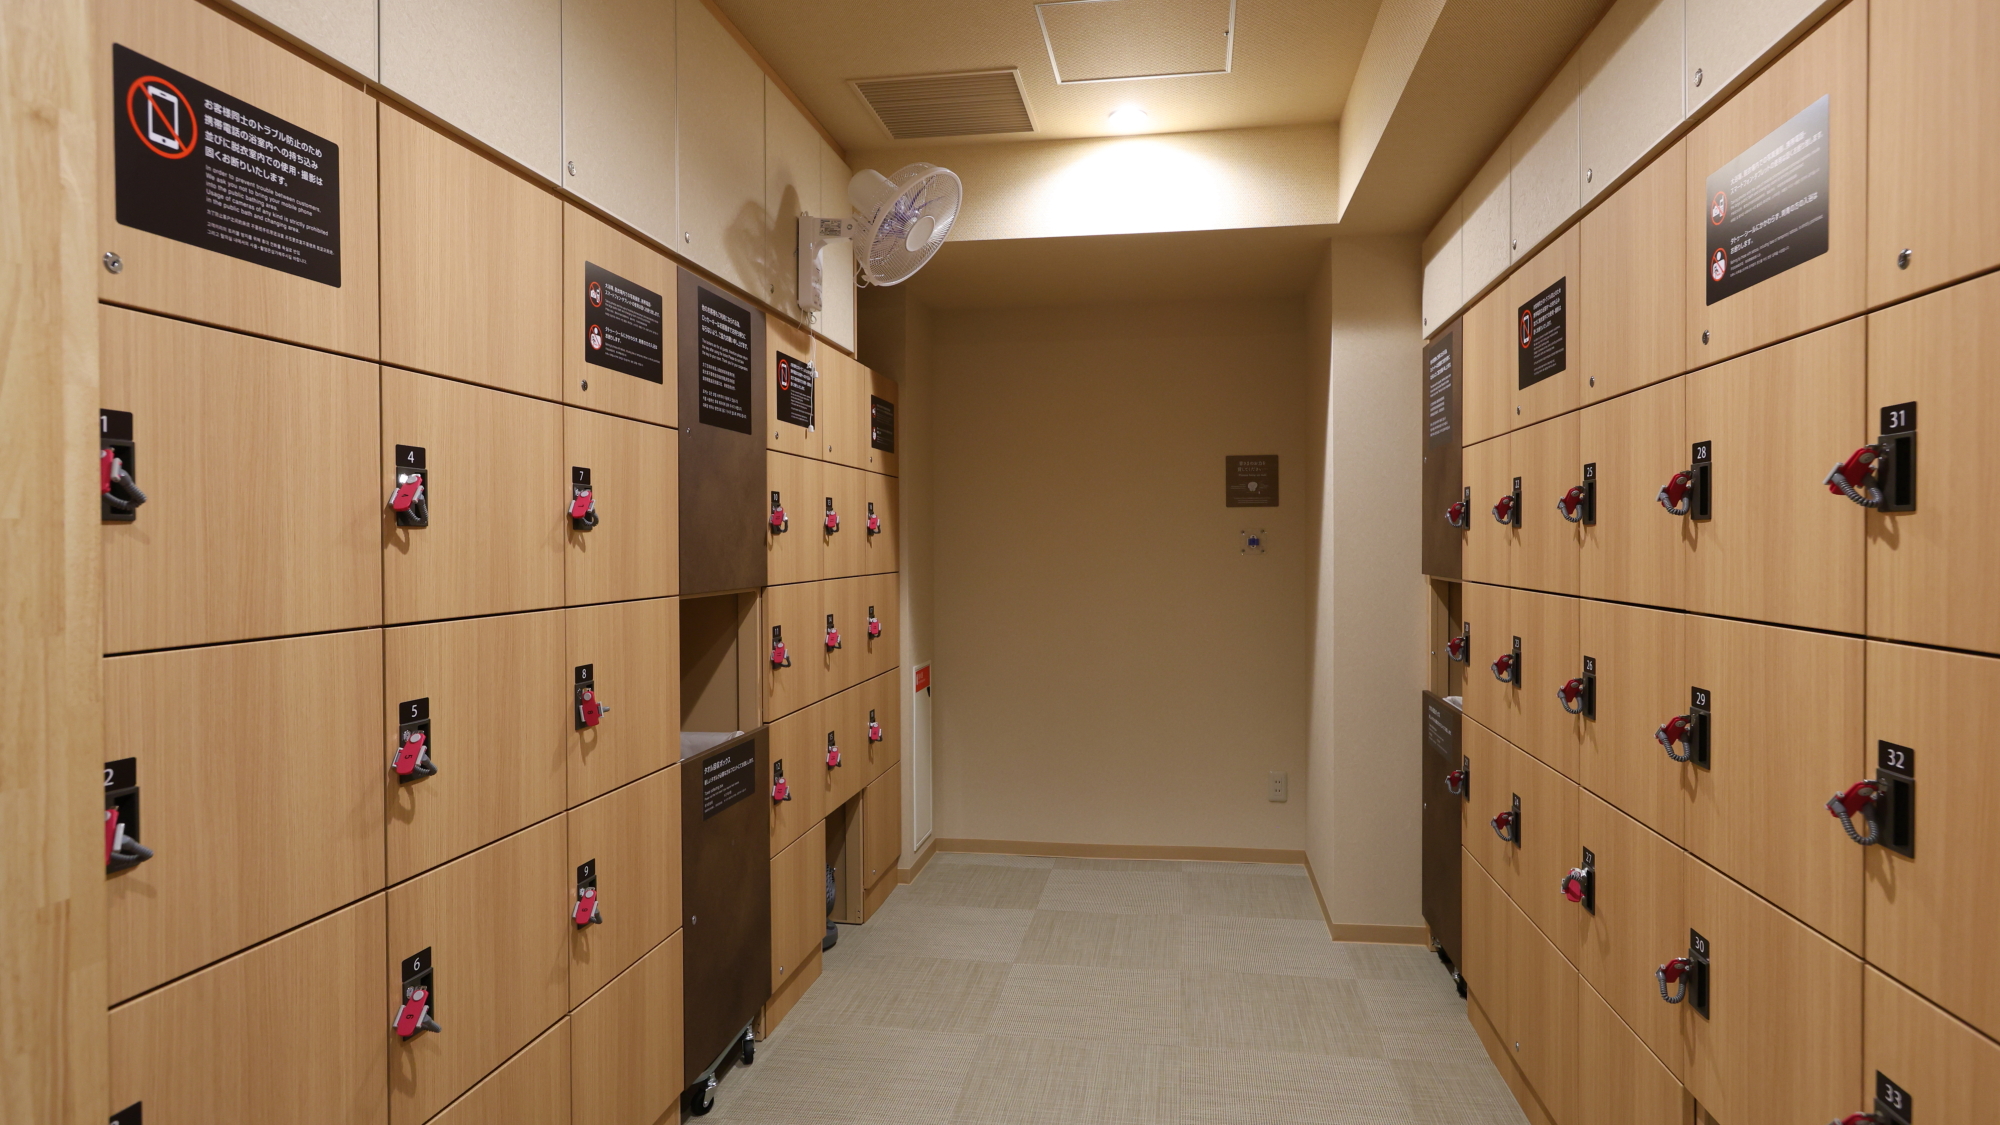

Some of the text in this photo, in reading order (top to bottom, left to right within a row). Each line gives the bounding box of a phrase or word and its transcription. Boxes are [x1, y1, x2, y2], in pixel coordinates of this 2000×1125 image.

[204, 98, 322, 158] お客様同士のトラブル防止のため
[204, 114, 318, 171] 携帯電話の浴室内への持ち込み
[205, 130, 322, 187] 並びに脱衣室内での使用・撮影は
[205, 147, 288, 187] 固くお断りいたします。
[206, 181, 216, 189] into
[228, 189, 244, 199] public
[245, 195, 264, 207] bathing
[265, 203, 278, 211] area.
[213, 168, 226, 177] order
[235, 177, 255, 188] prevent
[256, 184, 273, 194] trouble
[275, 191, 295, 202] between
[296, 200, 321, 212] customers.
[228, 182, 237, 190] you
[255, 191, 268, 201] bring
[269, 197, 279, 205] your
[281, 201, 296, 210] mobile
[298, 207, 312, 217] phone
[1889, 409, 1905, 429] 31
[407, 451, 415, 464] 4
[1697, 446, 1707, 460] 28
[579, 470, 585, 481] 7
[1586, 466, 1593, 478] 25
[581, 668, 587, 679] 8
[1586, 660, 1593, 671] 26
[1696, 692, 1706, 706] 29
[411, 704, 418, 718] 5
[1887, 749, 1905, 769] 32
[103, 769, 115, 786] 2
[1585, 852, 1592, 864] 27
[583, 865, 589, 877] 9
[1695, 936, 1705, 953] 30
[413, 957, 421, 971] 6
[1884, 1084, 1903, 1110] 33
